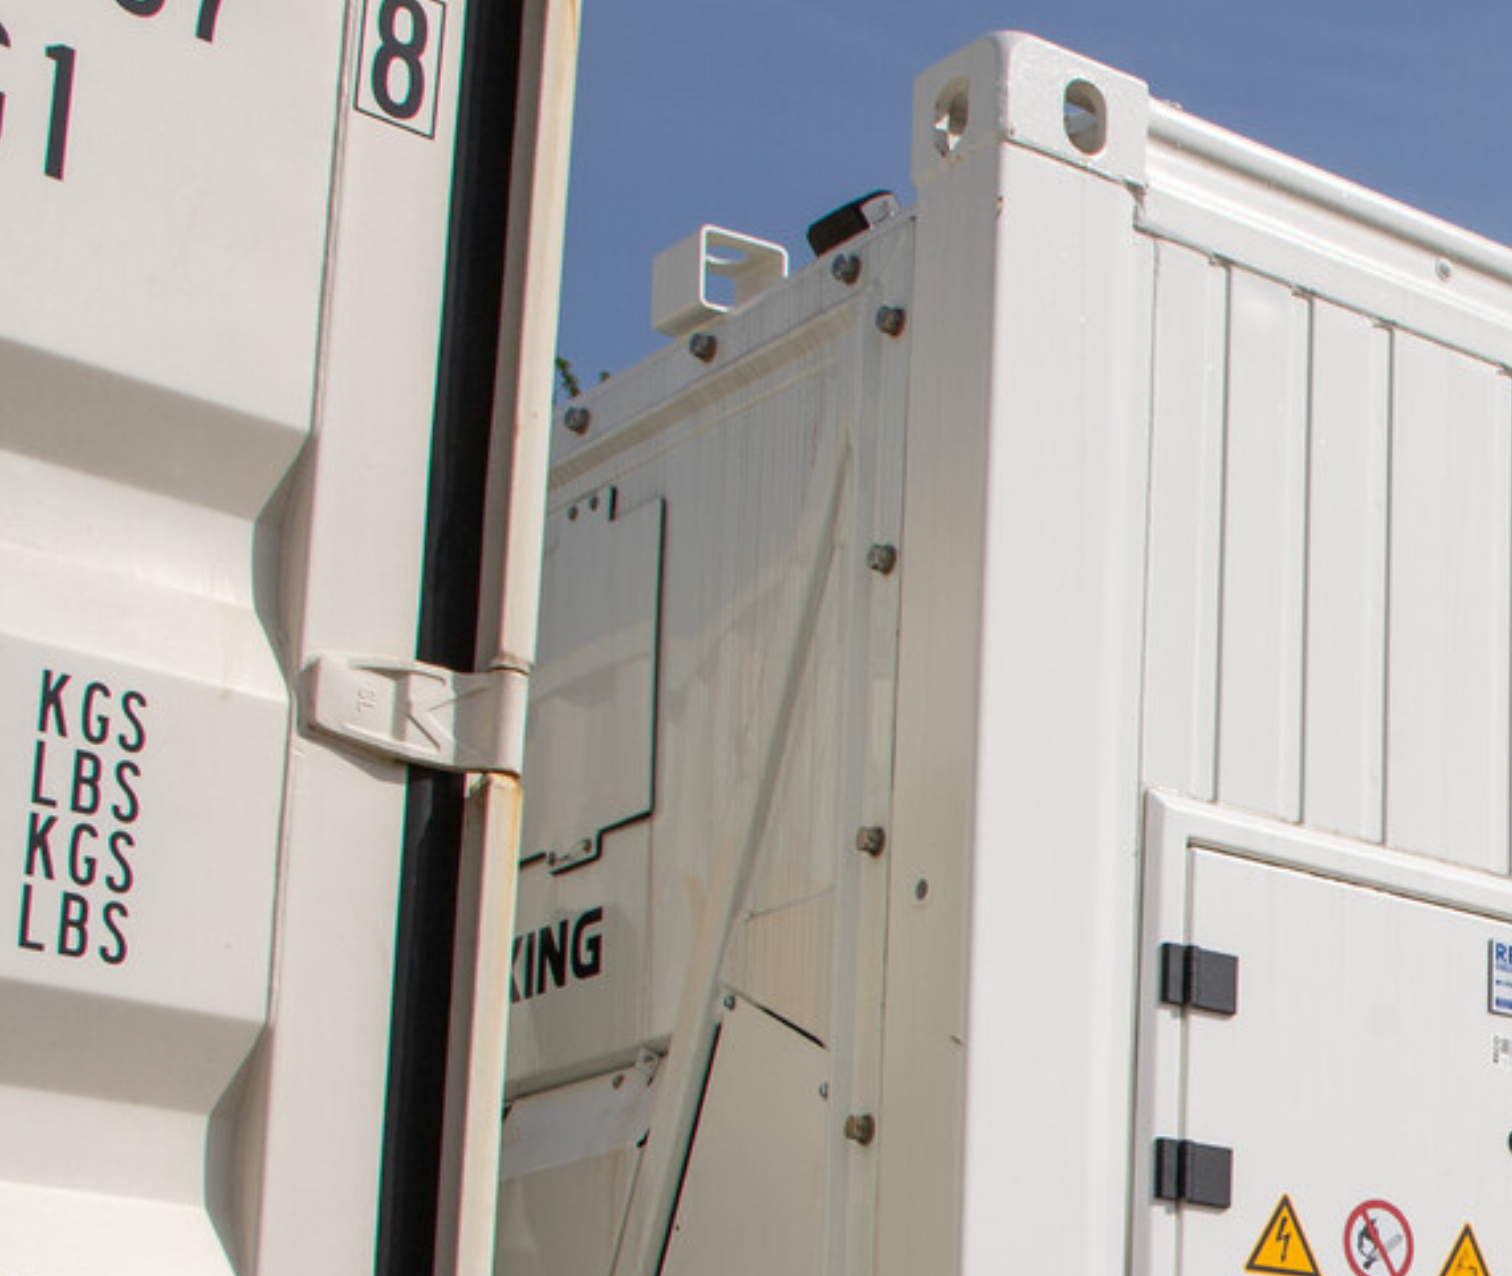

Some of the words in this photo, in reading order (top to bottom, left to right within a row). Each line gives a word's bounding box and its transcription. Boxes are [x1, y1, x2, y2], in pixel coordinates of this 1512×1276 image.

[371, 0, 428, 120] 8
[37, 669, 148, 754] KGS
[32, 740, 142, 823] LBS
[24, 815, 135, 893] KGS
[18, 885, 128, 965] LBS
